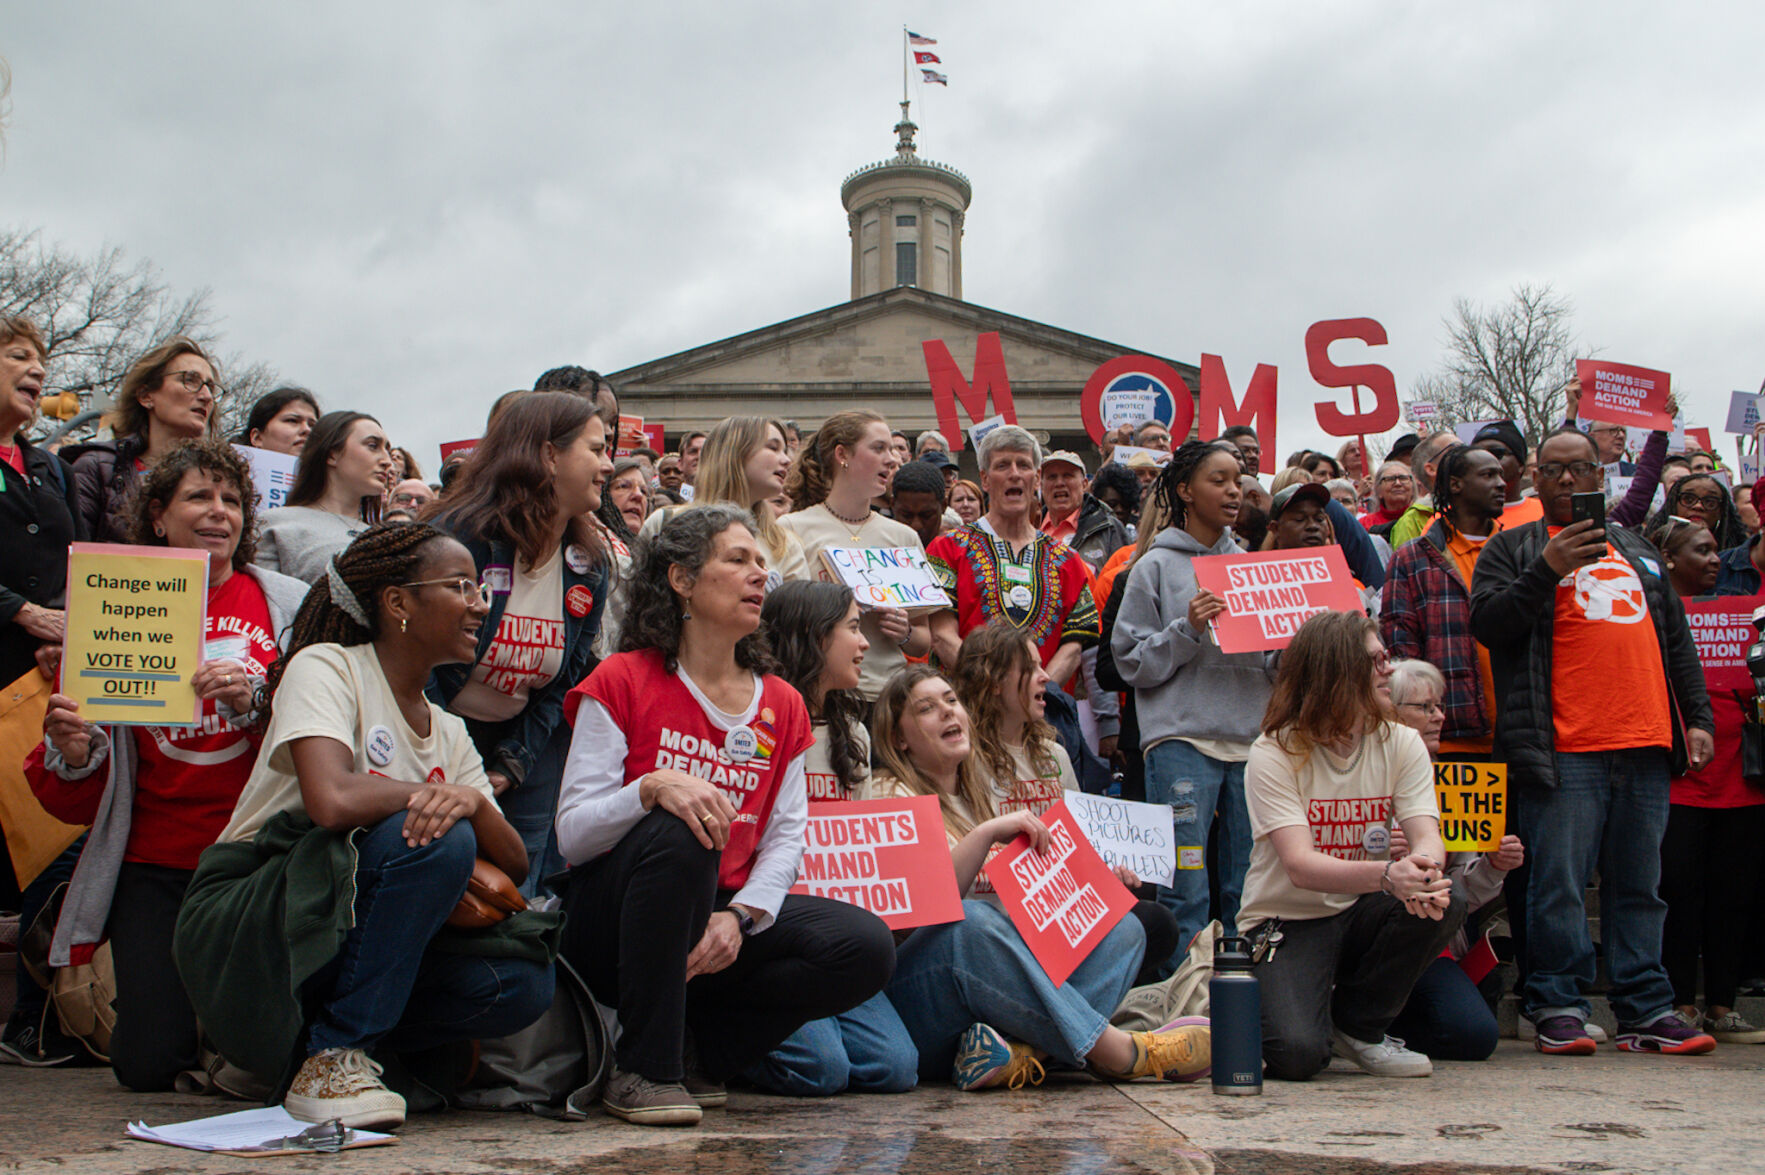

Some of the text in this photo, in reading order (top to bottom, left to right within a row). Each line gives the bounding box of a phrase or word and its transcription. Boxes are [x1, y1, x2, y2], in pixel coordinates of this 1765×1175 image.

[1595, 370, 1633, 386] MOMS
[1595, 381, 1648, 399] DEMAND
[1595, 392, 1641, 408] ACTION
[833, 549, 922, 569] CHANGE
[86, 574, 187, 593] Change will
[858, 569, 883, 585] IS
[1230, 560, 1329, 588] STUDENTS
[856, 583, 947, 605] COMING
[1227, 587, 1305, 613] DEMAND
[102, 601, 168, 618] happen
[217, 616, 275, 651] KILLING
[1264, 609, 1327, 636] ACTI
[93, 627, 173, 643] when we
[1690, 628, 1749, 642] EMAND
[86, 653, 176, 670] VOTE YOU
[483, 642, 543, 671] EMAND
[1695, 644, 1740, 657] TION
[104, 680, 156, 695] OUT!!
[660, 727, 733, 765] MOMS
[655, 750, 759, 791] DEMAND
[1434, 764, 1478, 786] KID
[1075, 797, 1133, 825] SHOOT
[1308, 799, 1391, 823] STUDENTS
[1460, 792, 1502, 814] THE
[805, 814, 915, 847] TUDENTS
[1089, 820, 1166, 849] PICTURES
[1311, 823, 1364, 846] EMAND
[1439, 820, 1492, 841] UNS
[798, 851, 876, 881] MAND
[1025, 867, 1077, 927] DEMAND
[1060, 887, 1105, 943] ACTION
[1236, 1074, 1252, 1082] YETI
